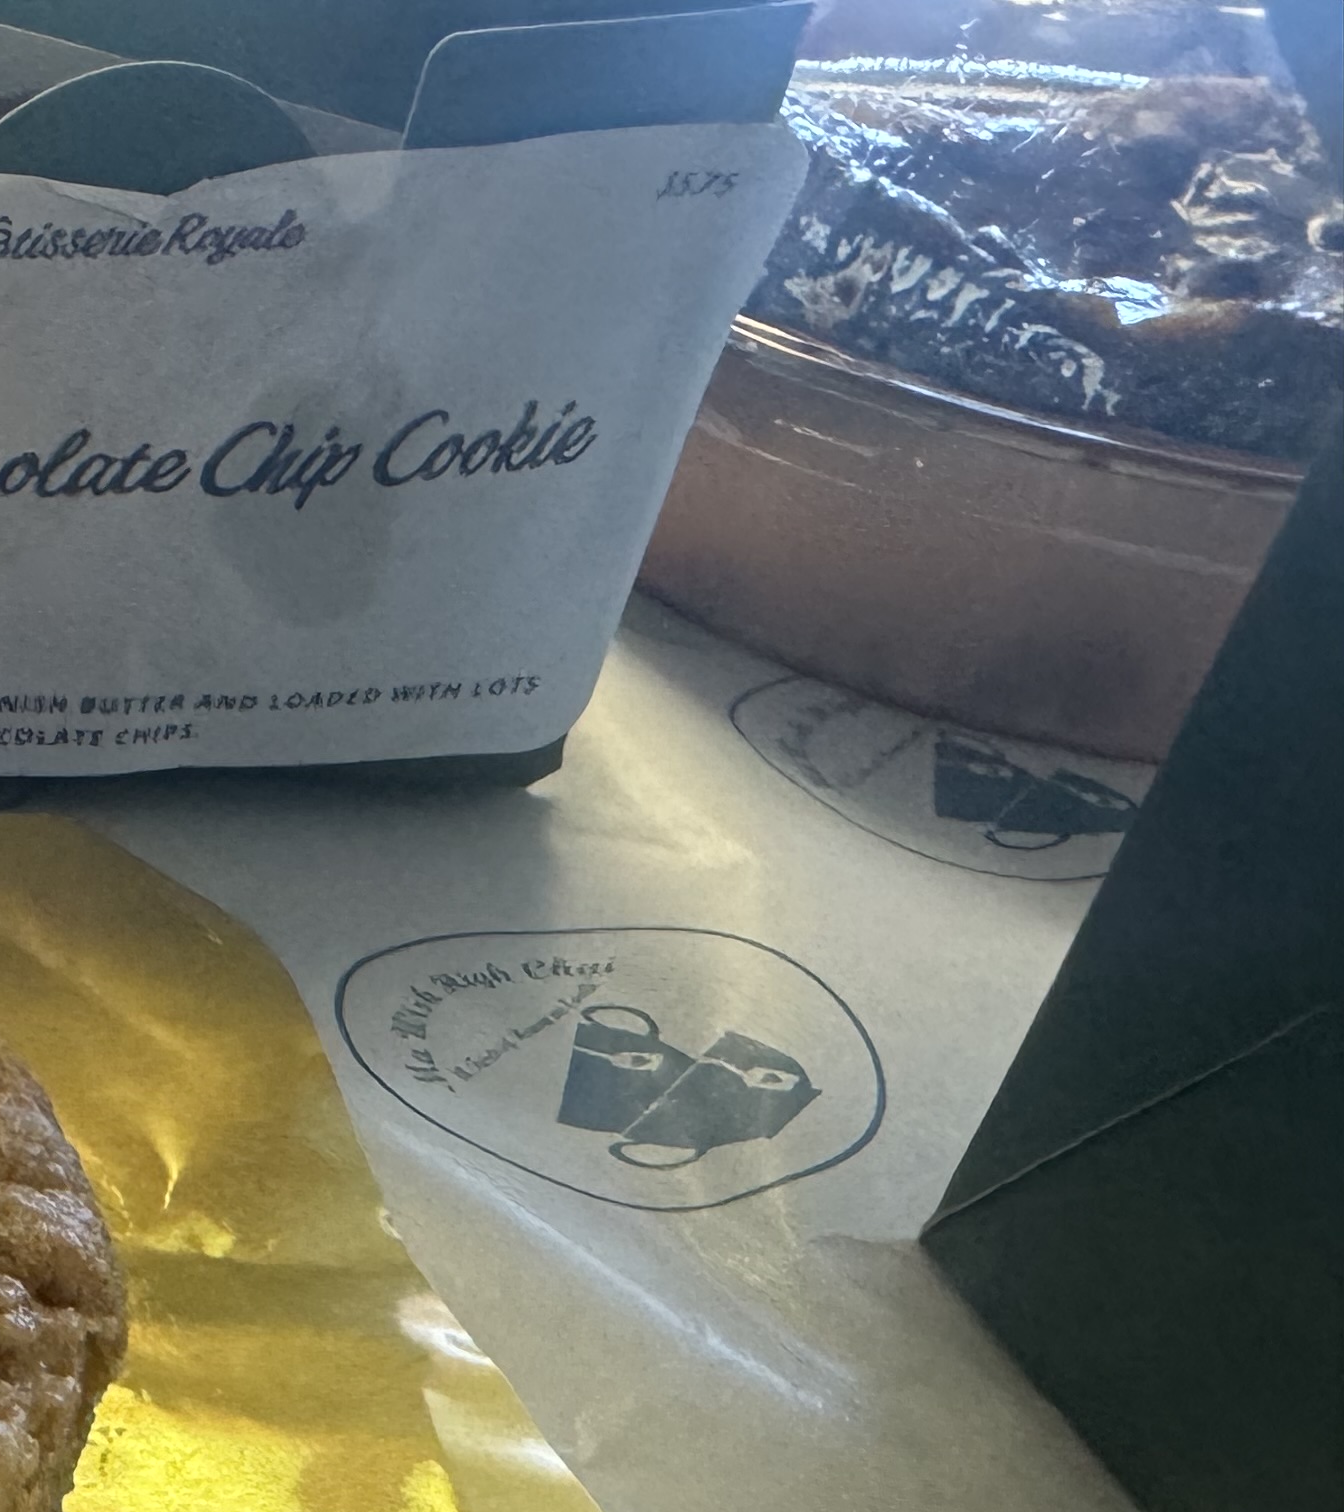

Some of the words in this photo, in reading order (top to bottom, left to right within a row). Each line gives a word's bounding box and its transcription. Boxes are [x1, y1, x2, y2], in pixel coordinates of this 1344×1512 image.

[159, 208, 307, 266] Royale
[199, 420, 363, 511] Chip
[372, 399, 600, 488] Cookie
[80, 693, 186, 716] BUTTER
[193, 693, 259, 713] AND
[268, 685, 383, 711] LOADED
[390, 679, 463, 705] WITH
[470, 674, 541, 698] LOTS
